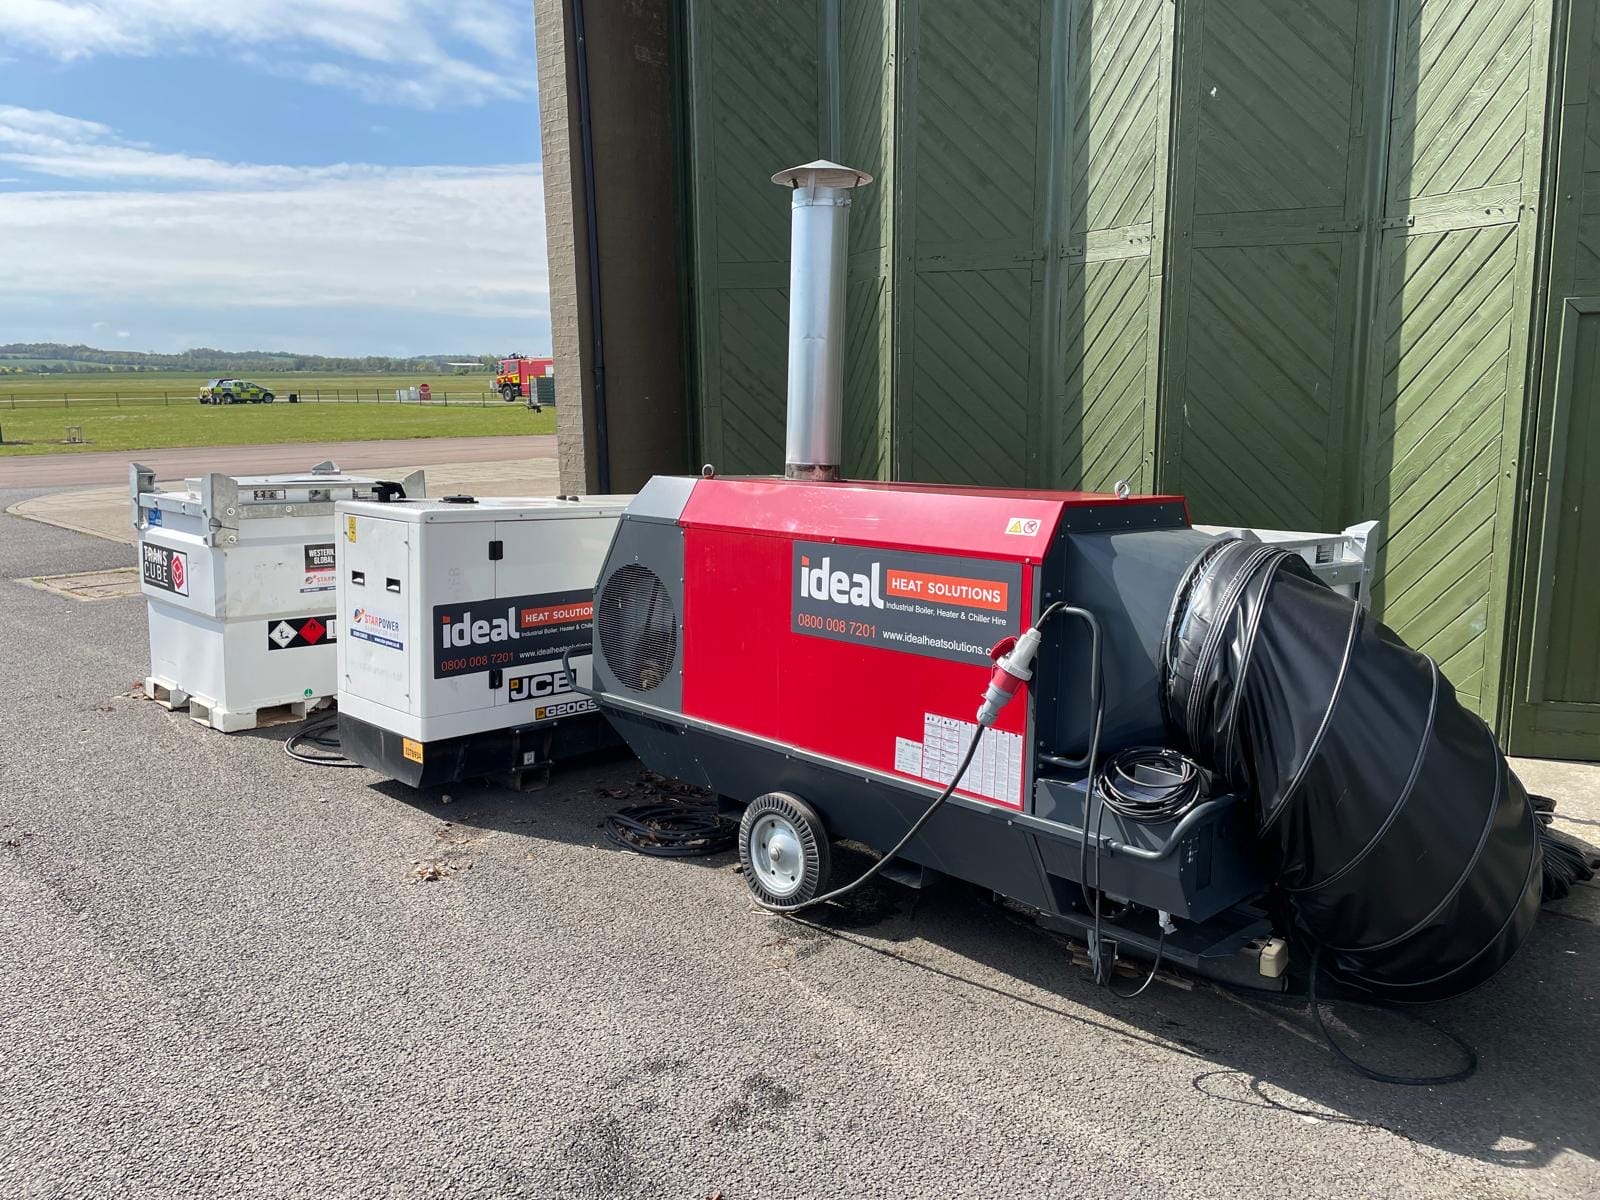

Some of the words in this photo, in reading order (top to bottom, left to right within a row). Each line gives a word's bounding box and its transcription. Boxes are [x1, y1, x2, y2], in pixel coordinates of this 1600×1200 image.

[143, 545, 168, 566] TRANS
[314, 556, 334, 564] GLOBAL
[144, 561, 168, 582] CUBE
[800, 555, 884, 609] ideal
[891, 577, 923, 593] HEAT
[927, 582, 1001, 603] SOLUTIONS
[364, 614, 399, 632] STARPOWER
[525, 612, 549, 623] HEAT
[886, 601, 914, 613] Industrial
[915, 605, 935, 617] Boiler,
[936, 609, 960, 619] Heater
[960, 611, 966, 620] &
[968, 612, 991, 624] Chiller
[991, 616, 1007, 626] Hire
[442, 606, 520, 649] ideal
[798, 613, 823, 628] 0800
[826, 617, 846, 633] 008
[849, 621, 876, 638] 7201
[882, 630, 991, 656] www.idealheatsolutions.c
[441, 659, 467, 672] 0800
[470, 656, 488, 667] 008
[491, 652, 514, 664] 7201
